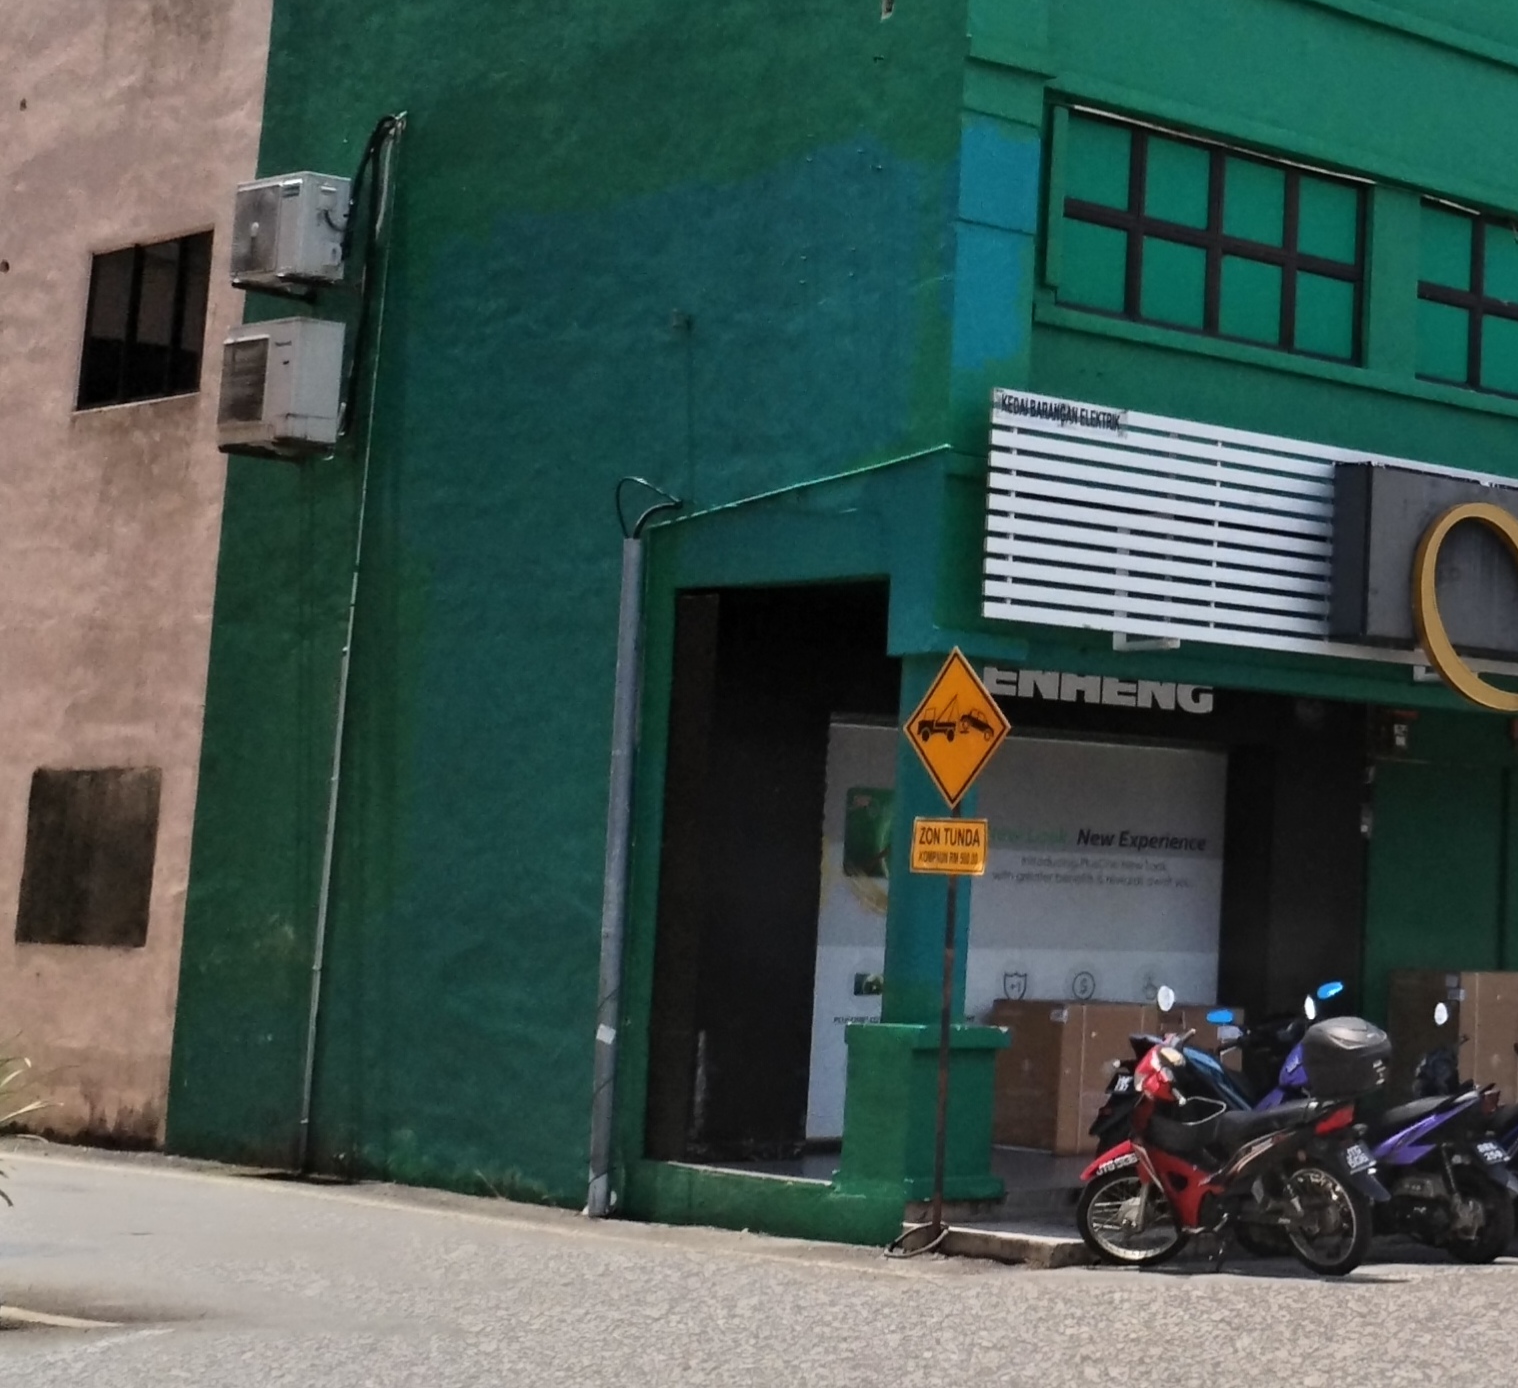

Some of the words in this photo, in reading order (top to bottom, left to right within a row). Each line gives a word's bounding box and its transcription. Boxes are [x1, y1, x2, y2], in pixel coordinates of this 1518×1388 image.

[1001, 394, 1028, 416] KEDAI
[1079, 407, 1121, 430] ELEKTRIK
[983, 666, 1214, 714] ENHENG
[919, 826, 941, 845] ZON
[944, 827, 981, 848] TUNDA
[1076, 828, 1114, 846] New
[1118, 830, 1207, 852] Experience
